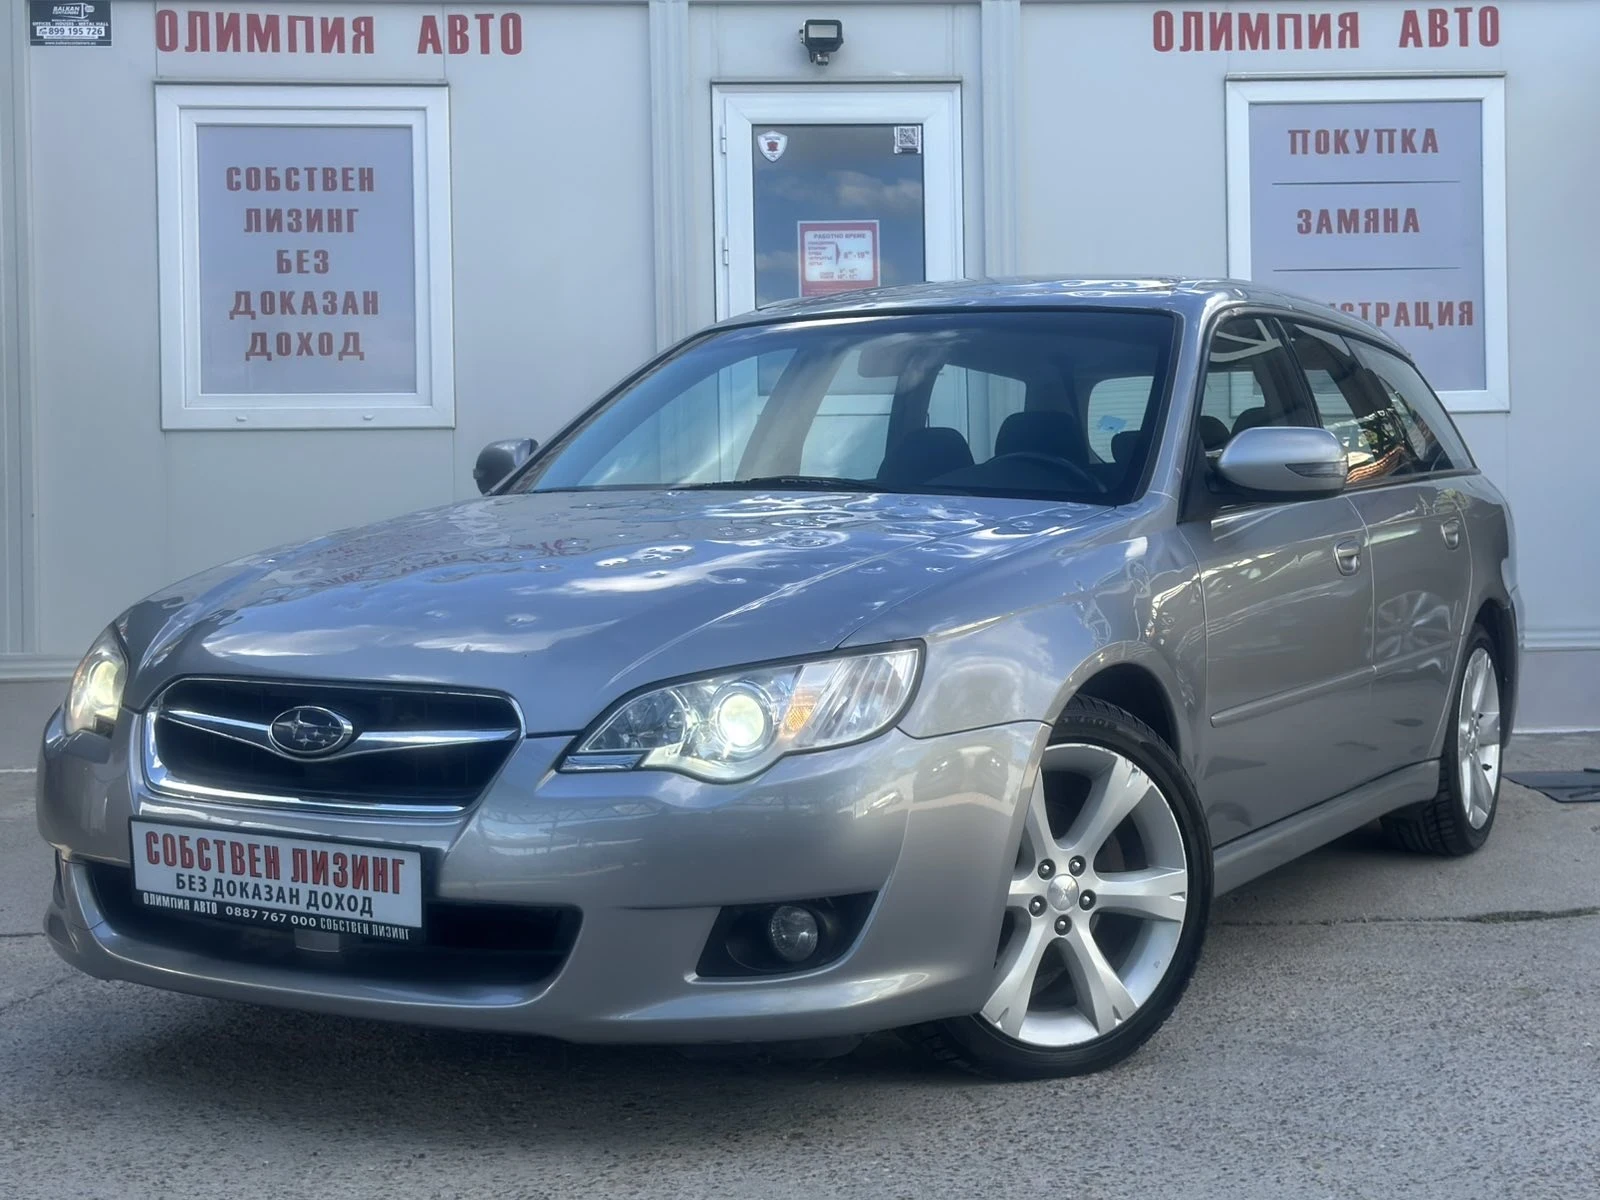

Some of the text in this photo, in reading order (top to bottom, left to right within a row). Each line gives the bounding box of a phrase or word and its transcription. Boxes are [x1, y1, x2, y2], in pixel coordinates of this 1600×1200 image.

[48, 27, 103, 35] 899 195 726
[156, 9, 523, 56] ОЛИМПИЯ АВТО
[1152, 5, 1500, 53] ОЛИМПИЯ АВТО
[1288, 128, 1439, 155] ПОКУПКА
[225, 166, 375, 192] СОБСТВЕН
[243, 208, 360, 233] ЛИЗИНГ
[1296, 207, 1421, 234] ЗАМЯНА
[276, 249, 330, 274] БЕЗ
[229, 291, 379, 320] ДОКАЗАН
[245, 331, 365, 361] ДОХОД
[145, 831, 405, 895] СОБСТВЕН ЛИЗИНГ
[175, 872, 374, 918] БЕЗ ДОКАЗАН ДОХОД
[143, 891, 411, 941] ОЛИМПИЯ АВТО 0887 767 000 СОБСТВЕН ЛИЗИНГ
